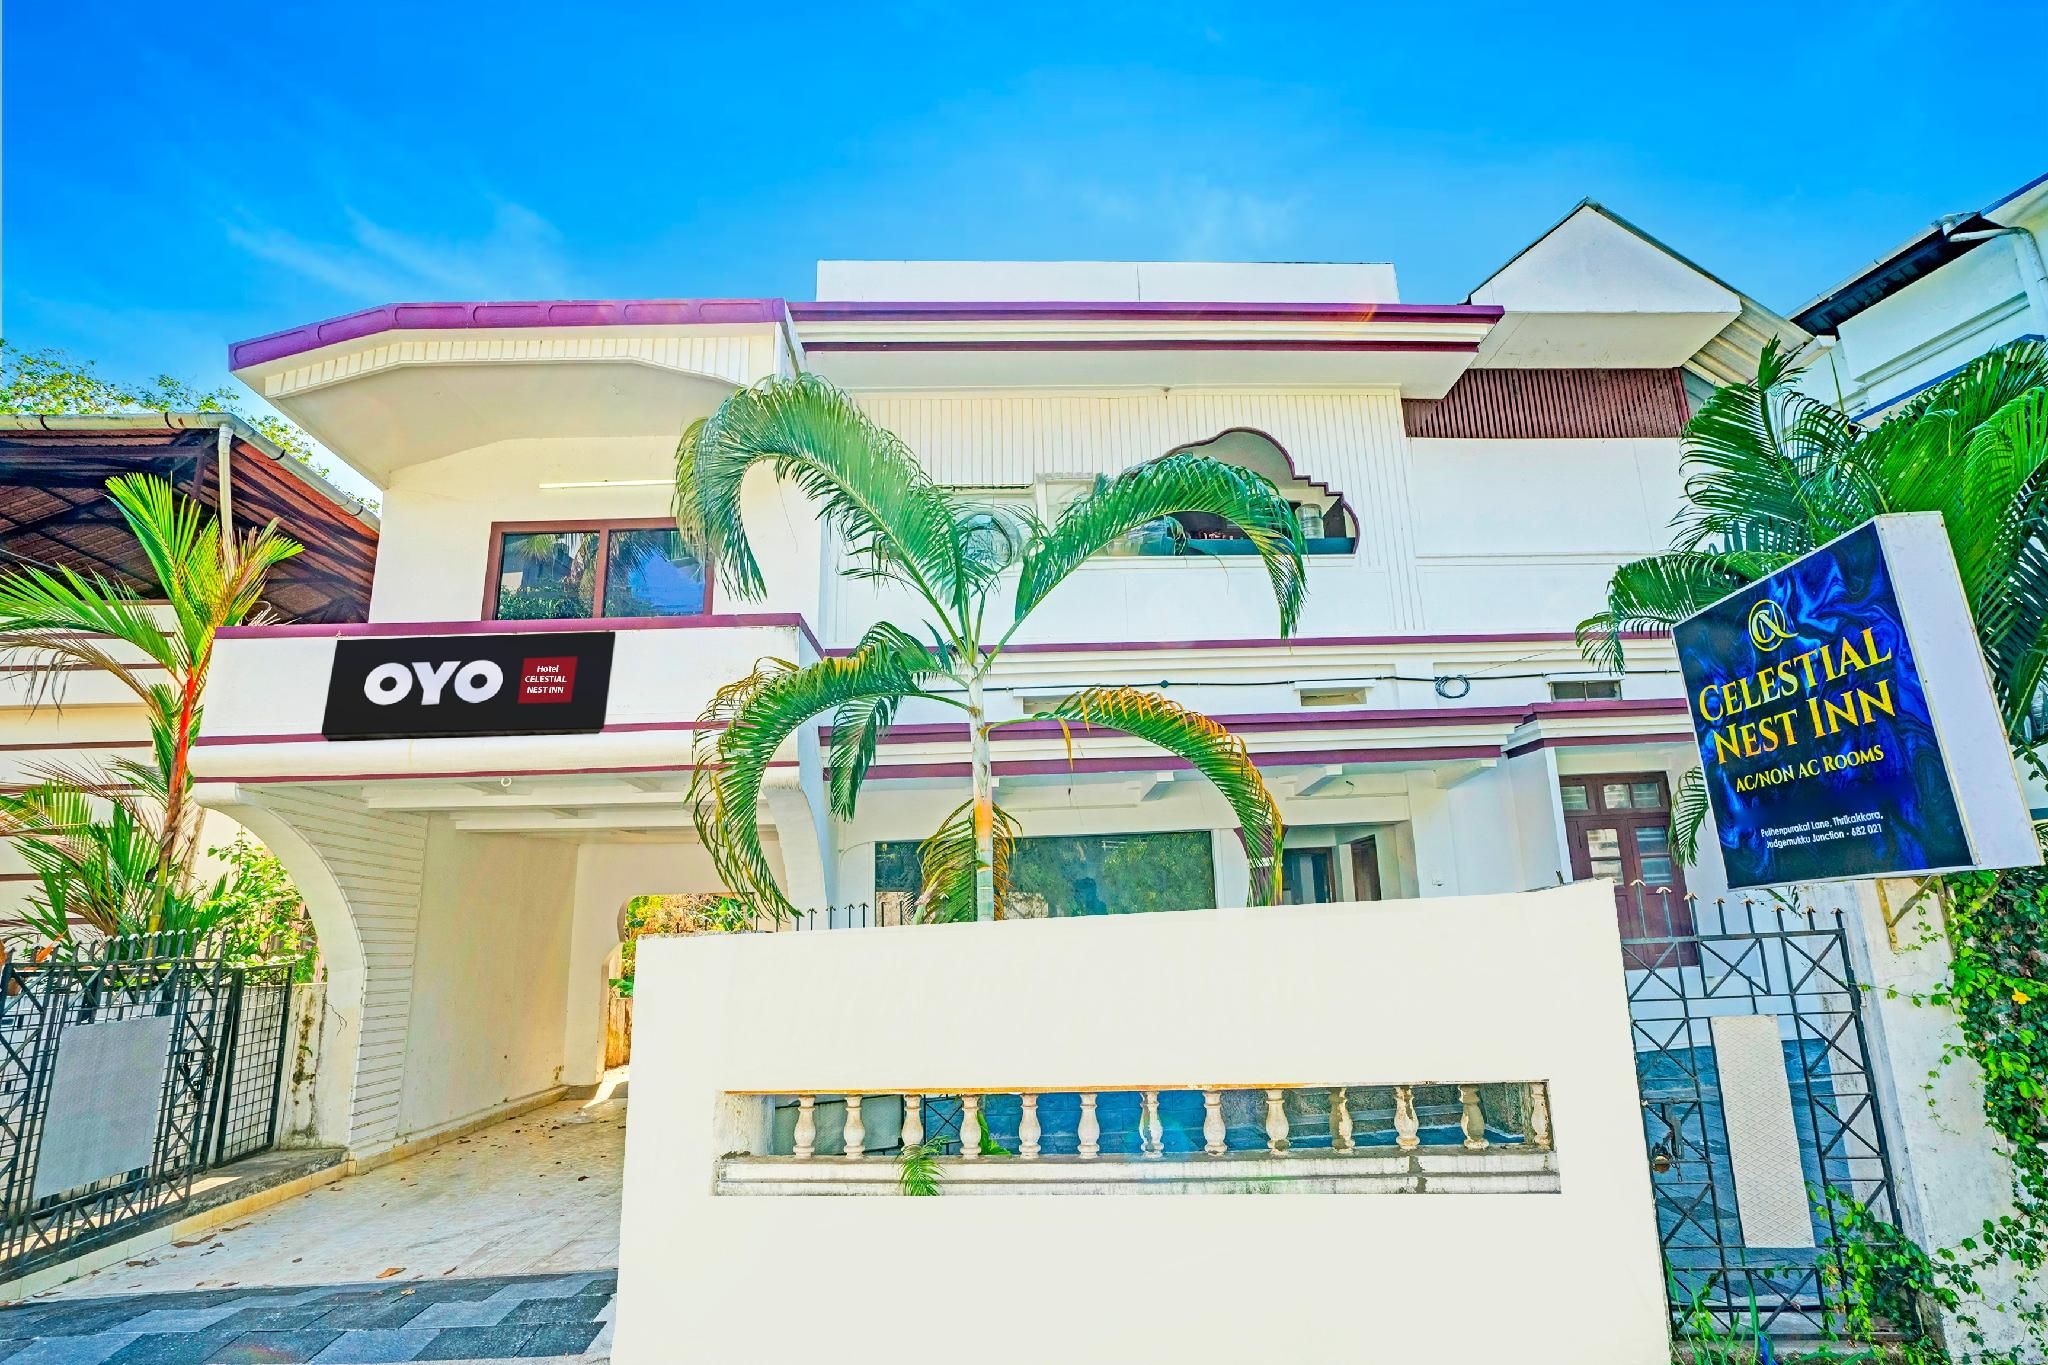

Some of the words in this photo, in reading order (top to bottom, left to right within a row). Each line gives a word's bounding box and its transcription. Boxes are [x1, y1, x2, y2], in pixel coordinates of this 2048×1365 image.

[536, 664, 560, 673] Hotel
[1699, 627, 1892, 722] CELESTIAL
[364, 659, 504, 706] OYO
[524, 675, 568, 683] CELESTIAL
[526, 686, 548, 694] NEST
[548, 686, 564, 694] INN
[1712, 709, 1798, 764] NEST
[1806, 679, 1896, 739] INN
[1736, 764, 1796, 793] AC/NON
[1798, 759, 1821, 779] AC
[1822, 744, 1885, 773] ROOMS
[1811, 820, 1833, 831] Lane,
[1811, 830, 1845, 843] Junction
[1851, 825, 1867, 837] 682
[1867, 823, 1883, 835] 021
